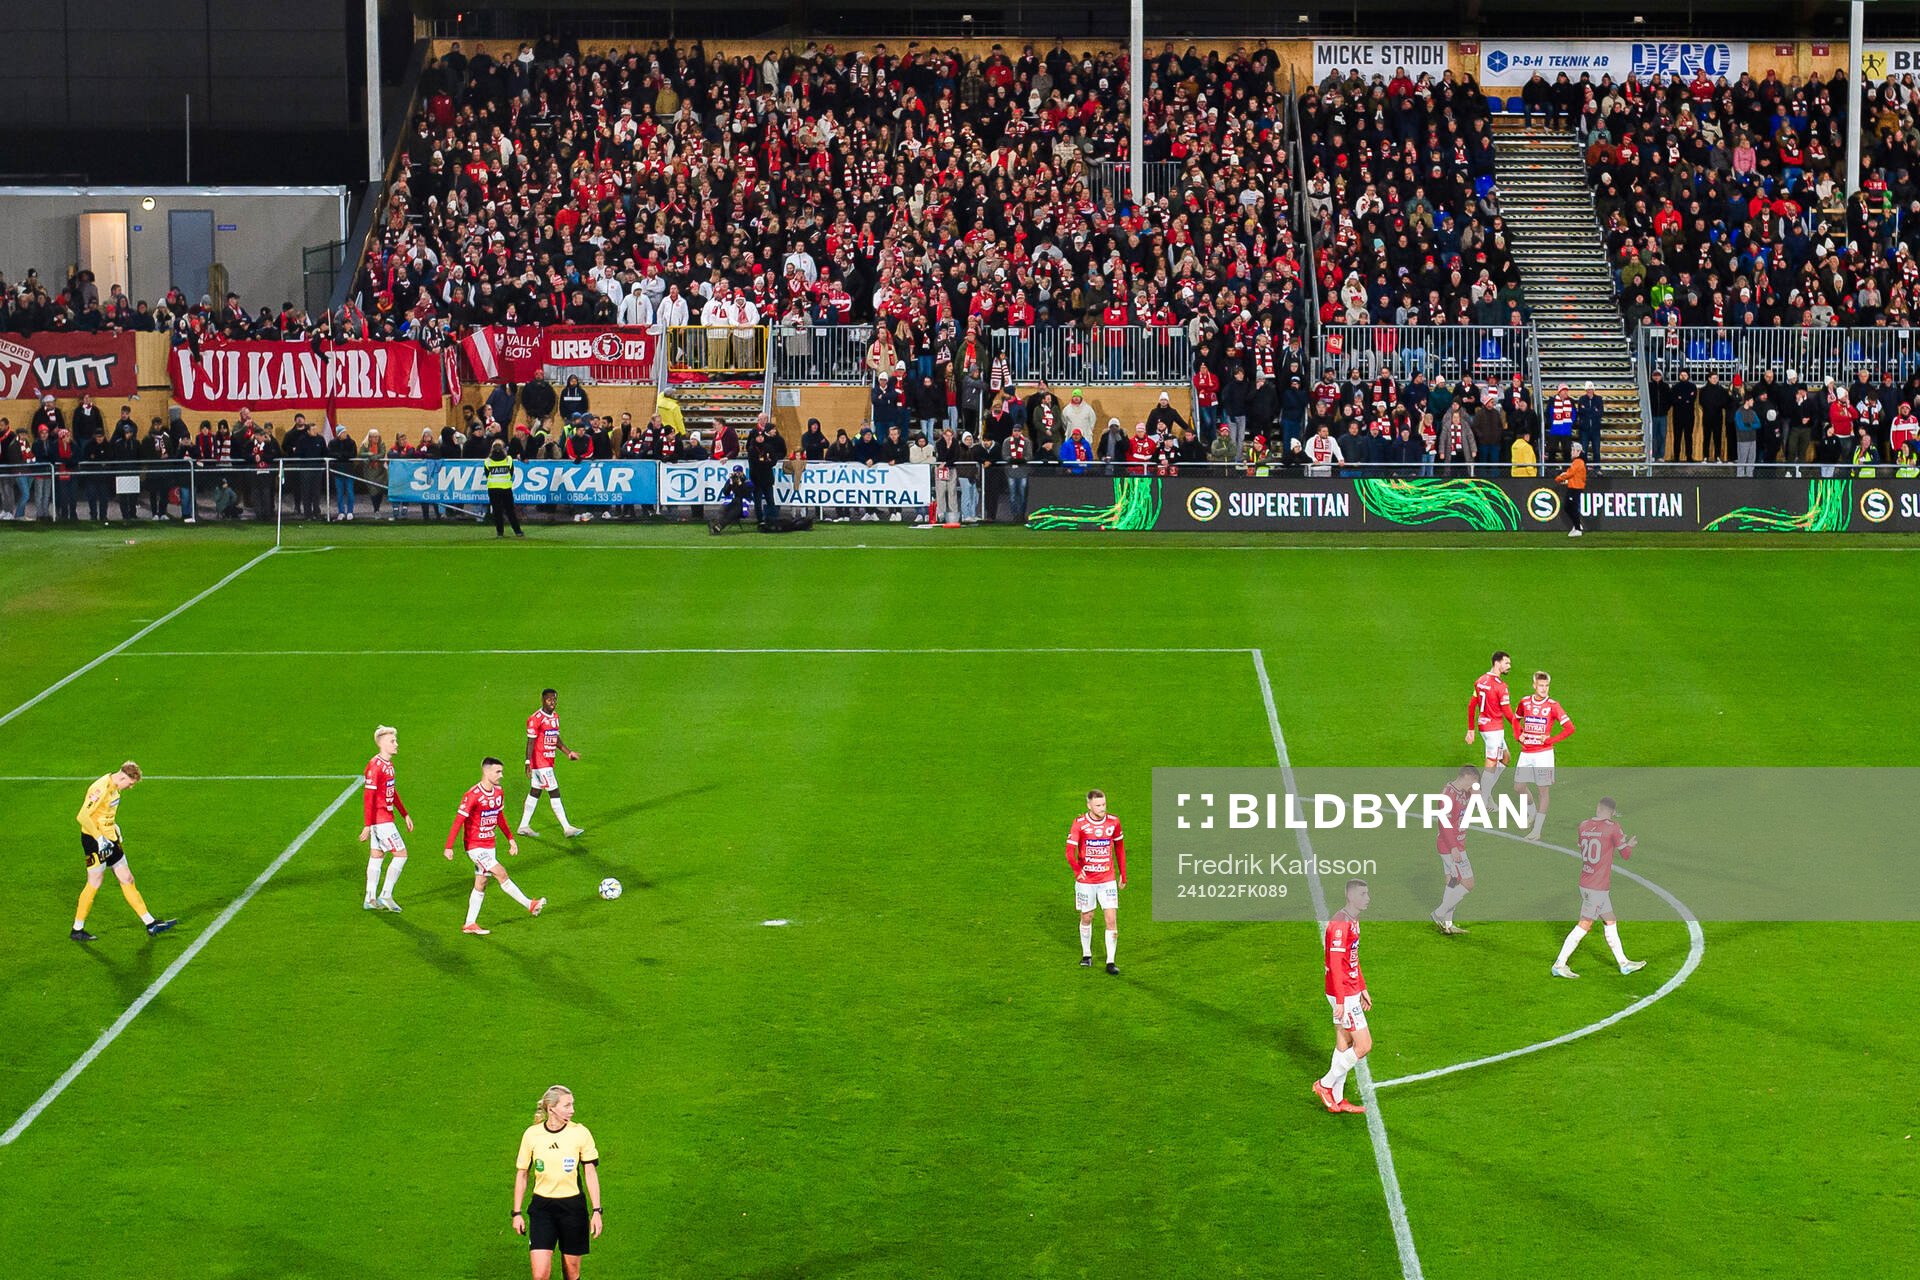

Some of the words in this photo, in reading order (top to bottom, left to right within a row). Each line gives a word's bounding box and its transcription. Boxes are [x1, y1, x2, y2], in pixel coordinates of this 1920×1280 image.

[1318, 45, 1373, 65] MICKE
[1382, 45, 1443, 65] STRIDH
[1549, 56, 1590, 67] TEKNIK
[1593, 56, 1609, 66] AB
[507, 335, 540, 347] VALLA
[33, 355, 116, 388] VITT
[422, 491, 440, 501] Gas
[443, 491, 450, 501] &
[1228, 492, 1349, 517] SUPERETTAN
[1580, 492, 1683, 517] UPERETTAN
[1581, 838, 1601, 864] 20
